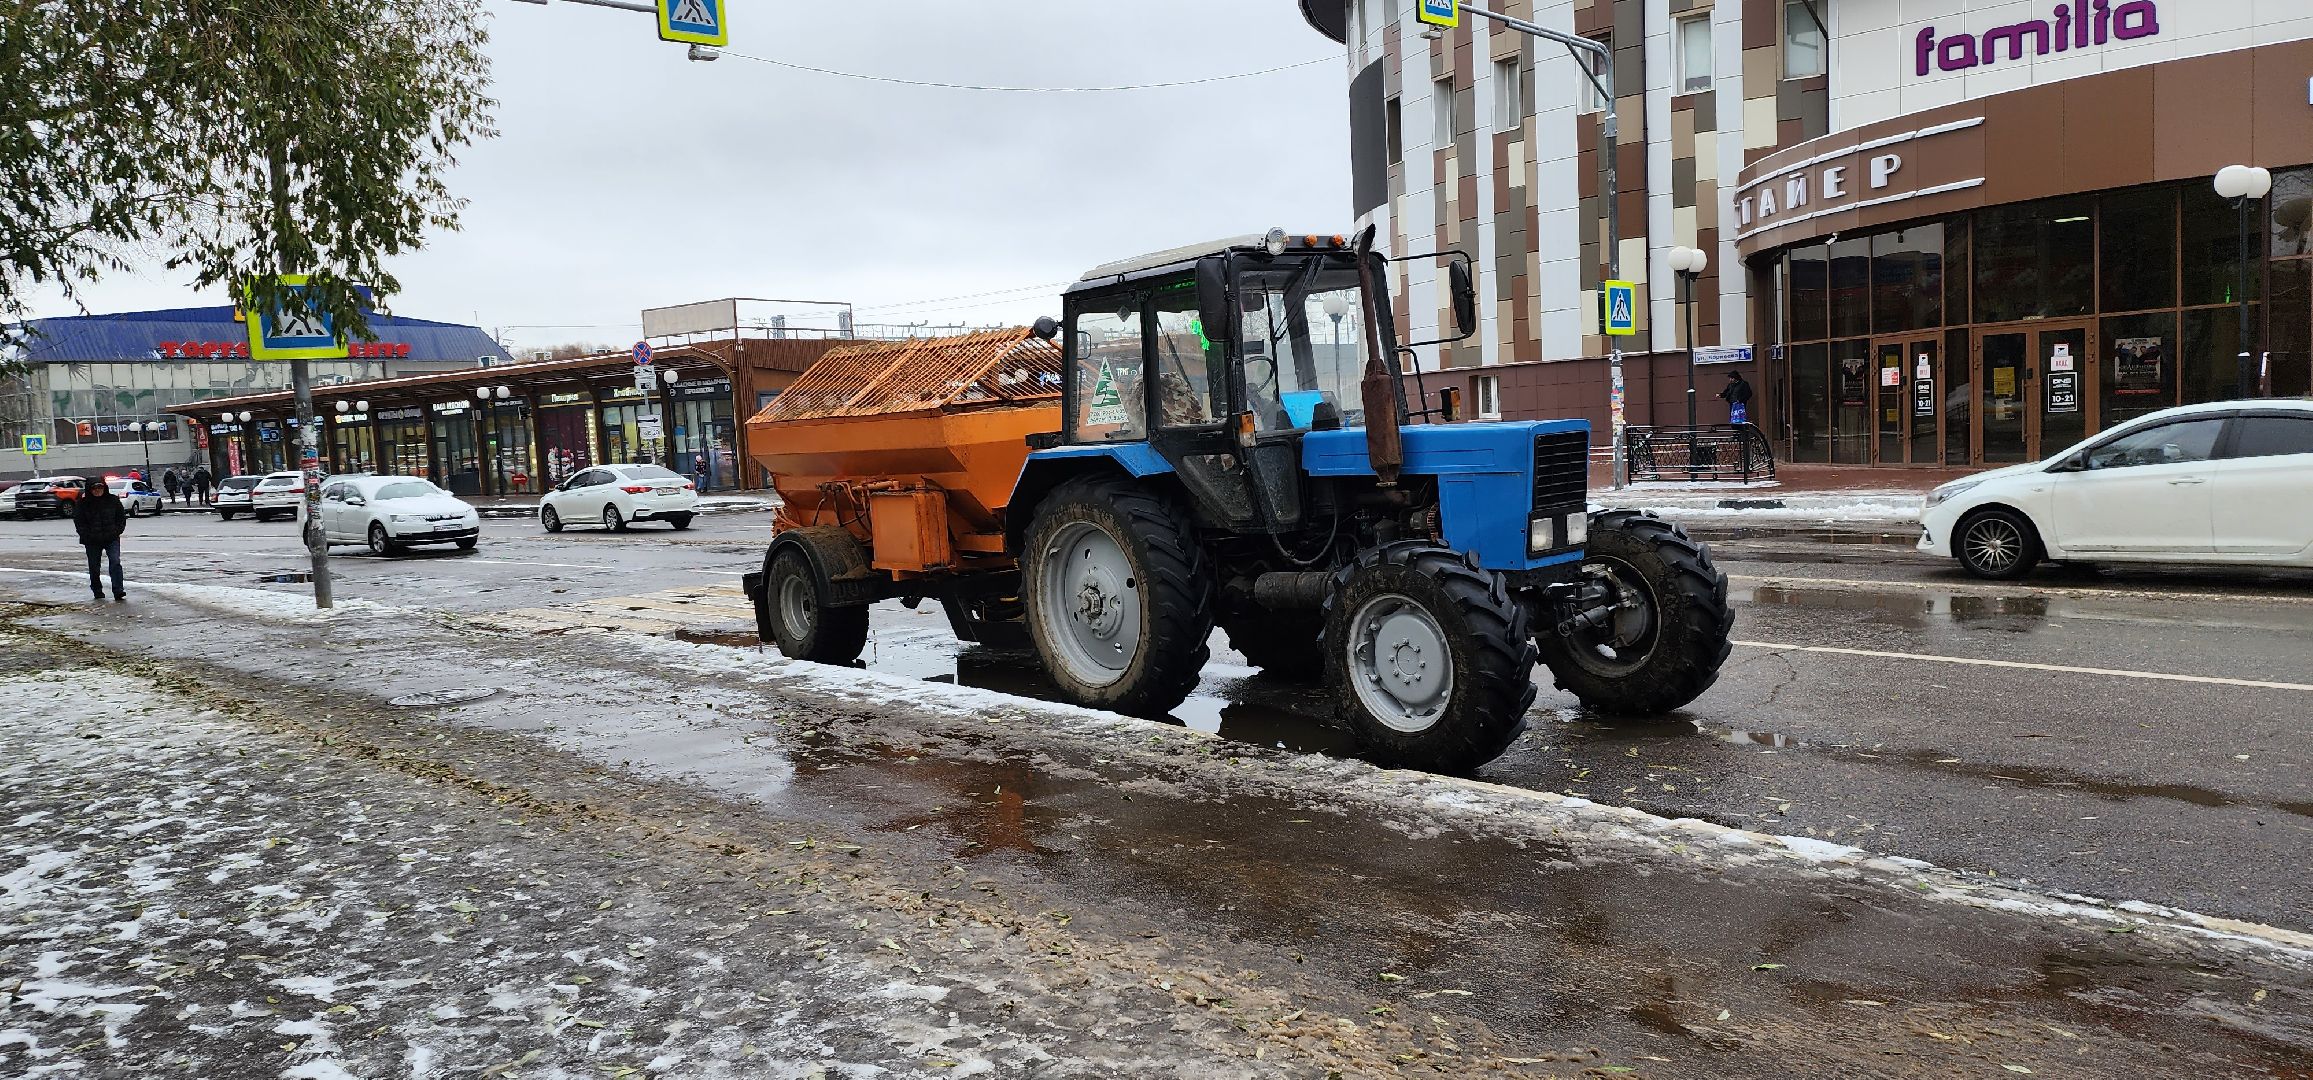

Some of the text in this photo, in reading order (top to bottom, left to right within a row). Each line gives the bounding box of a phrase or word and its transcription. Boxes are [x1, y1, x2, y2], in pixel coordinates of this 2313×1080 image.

[1916, 0, 2159, 77] familia
[1917, 399, 1931, 407] 10-21
[2051, 394, 2074, 403] 10-21
